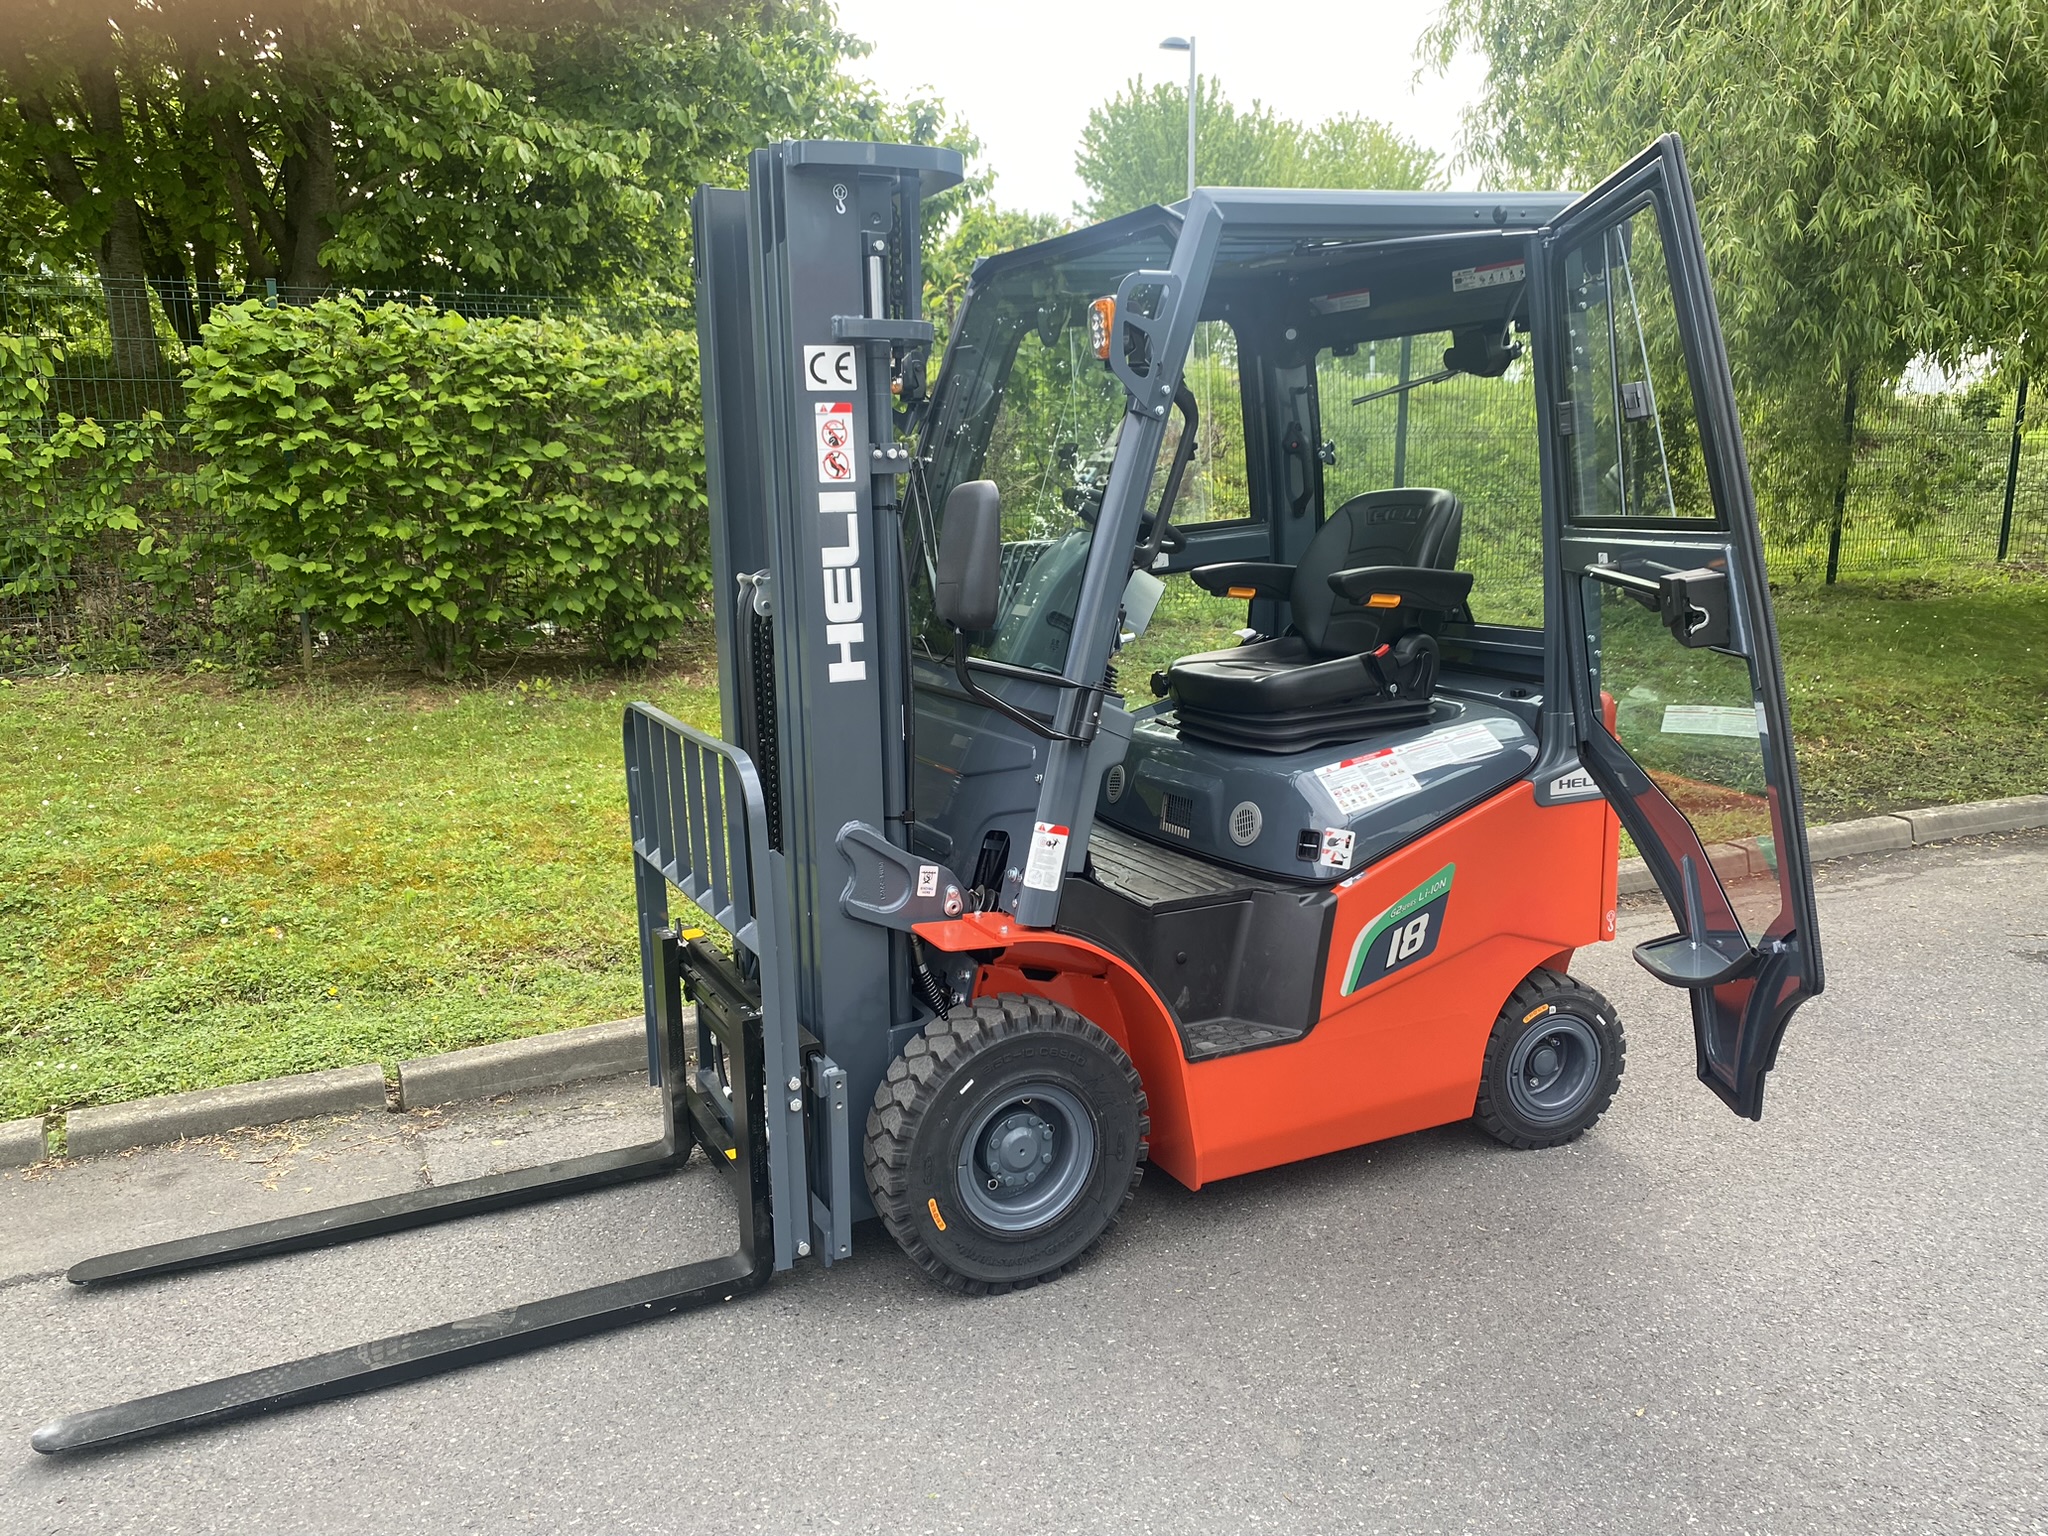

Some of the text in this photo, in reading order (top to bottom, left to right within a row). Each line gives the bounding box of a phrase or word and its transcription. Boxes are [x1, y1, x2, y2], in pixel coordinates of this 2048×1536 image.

[810, 352, 852, 384] CE
[818, 491, 867, 684] HELI
[1558, 777, 1596, 790] HEL
[1385, 912, 1430, 969] 18
